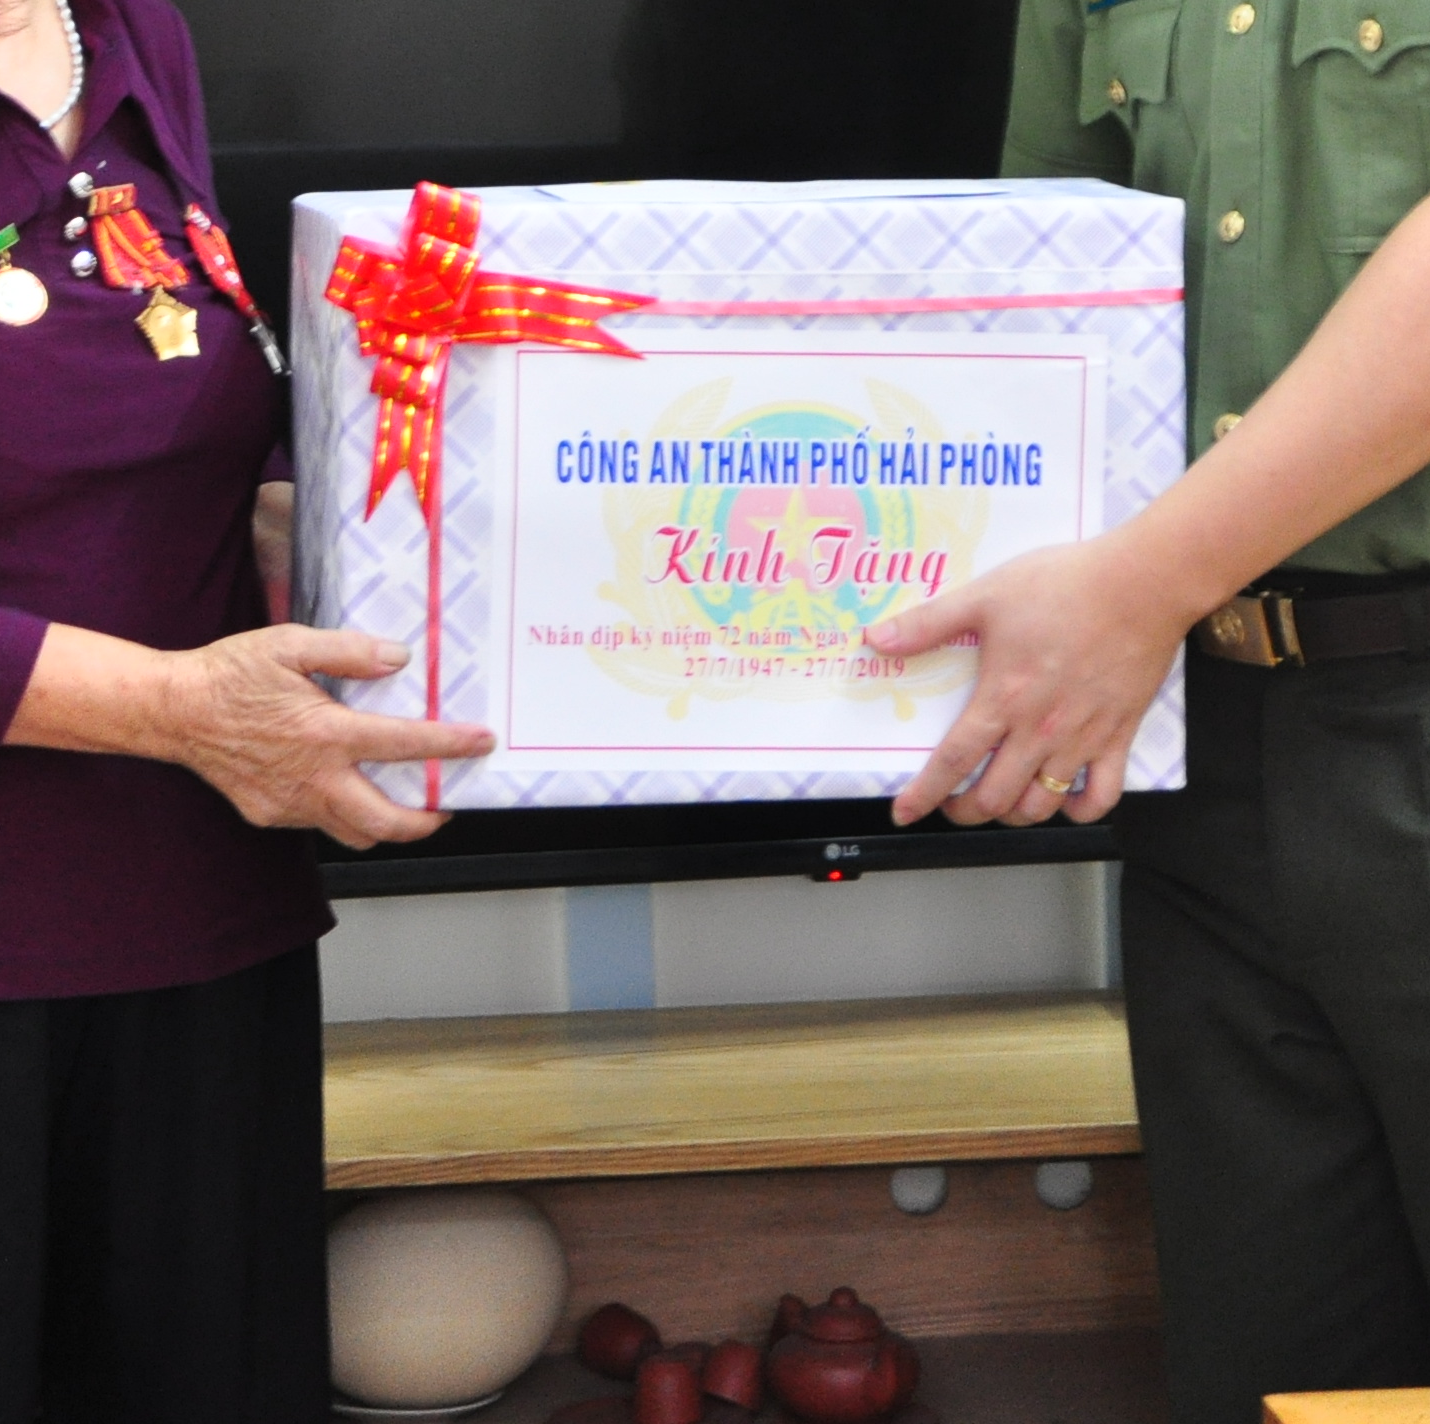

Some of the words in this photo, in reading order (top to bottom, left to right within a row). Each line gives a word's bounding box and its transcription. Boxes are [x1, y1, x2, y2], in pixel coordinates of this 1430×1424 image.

[556, 430, 640, 484] CÔNG
[649, 440, 691, 484] AN
[700, 431, 800, 484] THÀNH
[810, 426, 869, 485] PHỐ
[879, 427, 930, 485] HẢI
[939, 432, 1043, 486] PHÒNG
[646, 526, 790, 584] Kính
[810, 527, 949, 598] Tặng
[529, 625, 584, 645] Nhân
[591, 625, 624, 651] dịp
[662, 625, 712, 651] niệm
[719, 626, 741, 646] 72
[749, 626, 791, 646] năm
[799, 626, 849, 651] Ngày
[684, 657, 785, 677] 27/7/1947
[805, 657, 905, 678] 27/7/2019
[843, 844, 860, 857] LG
